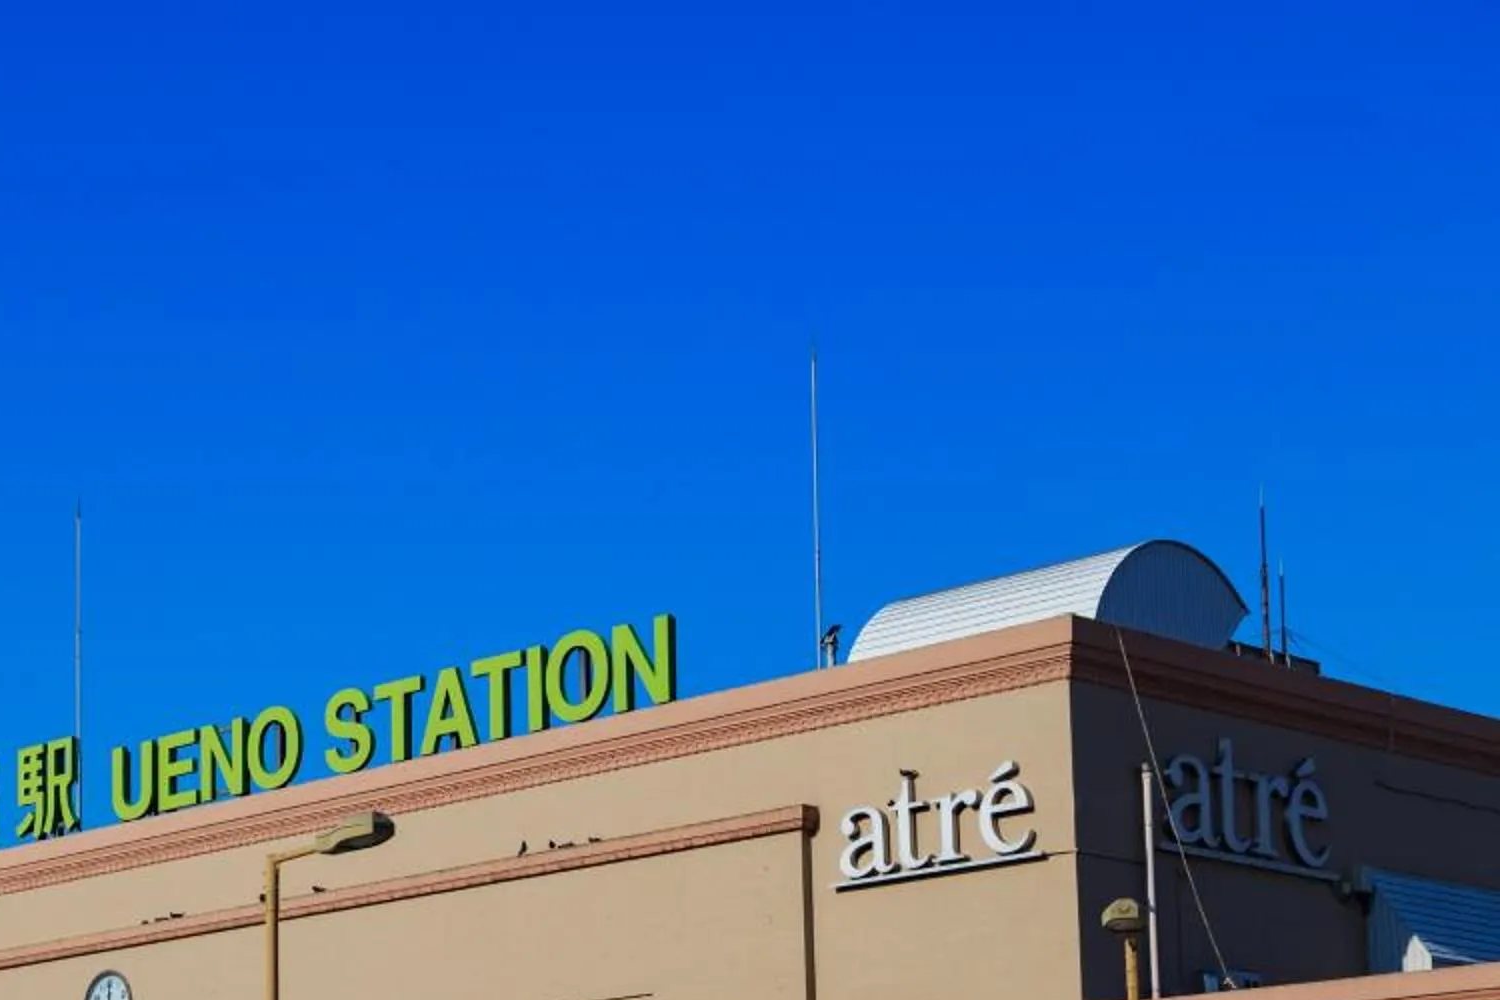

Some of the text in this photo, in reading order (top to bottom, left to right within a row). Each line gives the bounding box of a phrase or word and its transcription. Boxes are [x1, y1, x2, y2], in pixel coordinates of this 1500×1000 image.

[111, 706, 302, 822] UENO
[325, 614, 677, 774] STATION
[838, 760, 1037, 880] atré
[1163, 738, 1332, 868] atré
